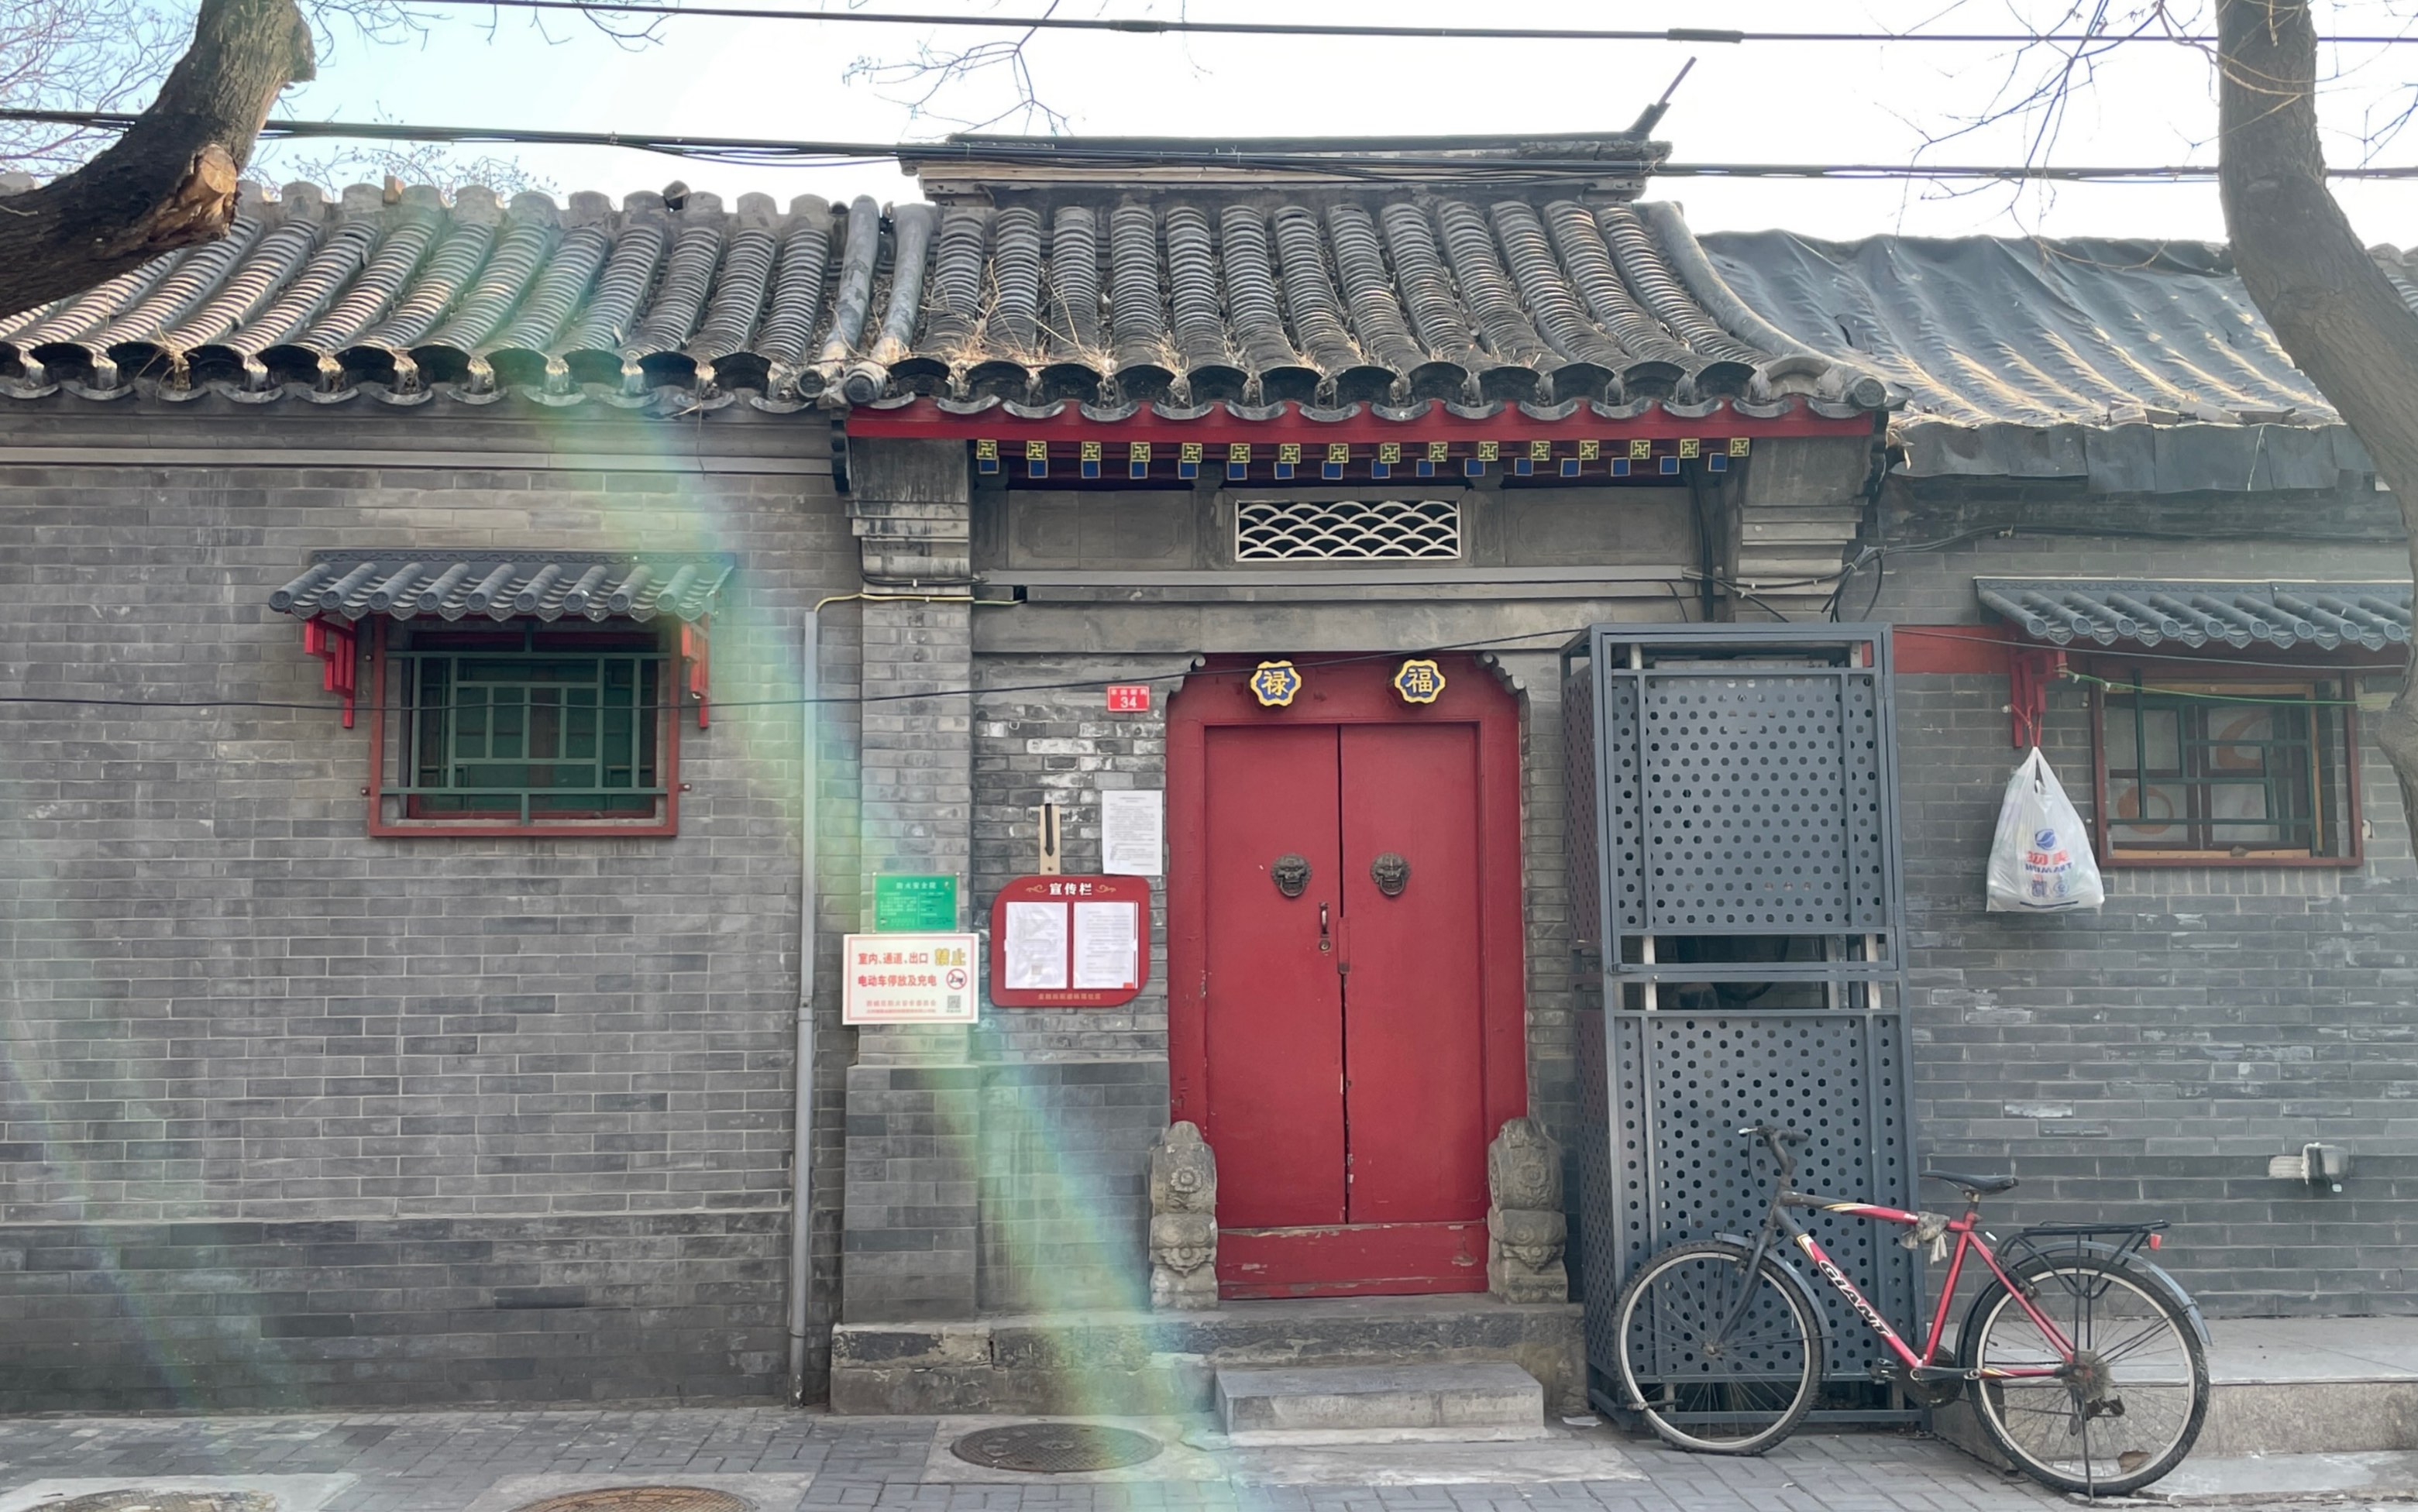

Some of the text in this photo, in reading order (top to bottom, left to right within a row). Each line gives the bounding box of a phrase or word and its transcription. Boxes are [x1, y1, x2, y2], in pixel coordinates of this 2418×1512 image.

[1261, 670, 1291, 696] 禄
[1405, 668, 1433, 693] 福
[1120, 696, 1137, 708] 34
[1049, 882, 1092, 895] 宣传栏
[858, 974, 937, 988] 电动车停放及充电
[1818, 1259, 1894, 1338] GIANT
